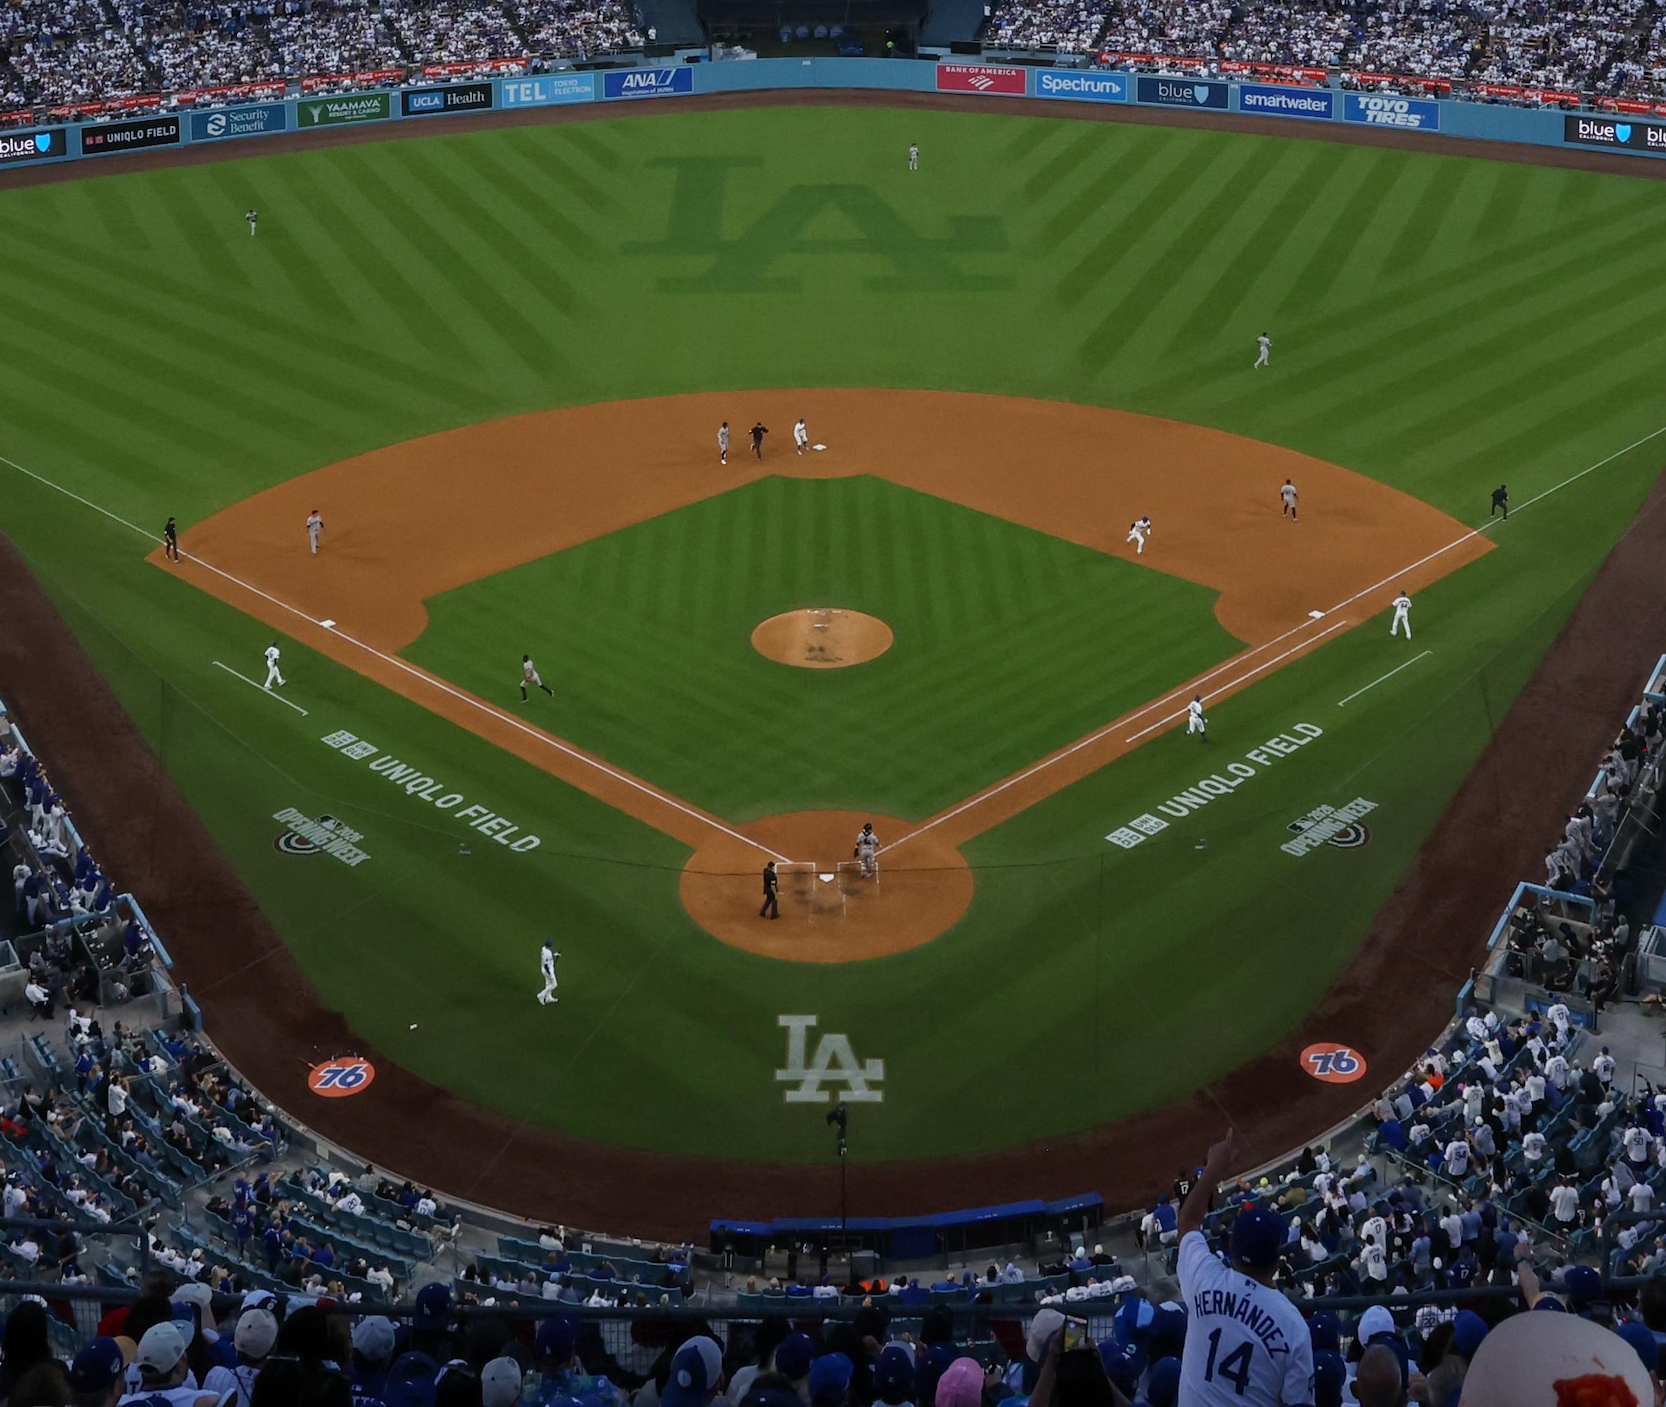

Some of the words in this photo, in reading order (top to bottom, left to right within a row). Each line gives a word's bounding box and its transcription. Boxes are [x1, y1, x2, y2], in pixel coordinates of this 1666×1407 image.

[945, 66, 969, 74] BANK
[980, 68, 1017, 76] AMERICA
[621, 73, 658, 88] ANA
[1041, 74, 1116, 94] Spectrum
[1158, 82, 1193, 97] blue
[413, 96, 440, 107] UCLA
[446, 90, 485, 105] Health
[504, 83, 546, 103] TEL
[1244, 93, 1328, 111] smartwater
[1358, 97, 1410, 111] TOYO
[229, 110, 269, 123] Security
[1366, 109, 1422, 127] TIRES
[106, 127, 144, 144] UNIQLO
[146, 125, 177, 139] FIELD
[230, 121, 265, 133] Benefit
[1578, 120, 1614, 136] blue
[0, 138, 34, 153] blue
[1578, 134, 1614, 142] CALIFORNIA
[0, 149, 35, 158] CALIFORNIA
[620, 155, 1017, 293] LA
[1246, 722, 1324, 766] FIELD
[1157, 762, 1256, 818] UNIQLO
[368, 755, 464, 809] UNIQLO
[454, 804, 542, 852] FIELD
[1307, 803, 1336, 820] 2026
[337, 825, 364, 843] 2026
[1279, 815, 1342, 857] OPENING
[1329, 796, 1379, 829] WEEK
[272, 807, 335, 850] OPENING
[327, 839, 372, 867] WEEK
[775, 1014, 884, 1102] LA
[1309, 1049, 1359, 1075] 76
[313, 1063, 370, 1089] 76
[1194, 1290, 1290, 1359] HERNÁNDEZ
[1204, 1327, 1255, 1396] 14
